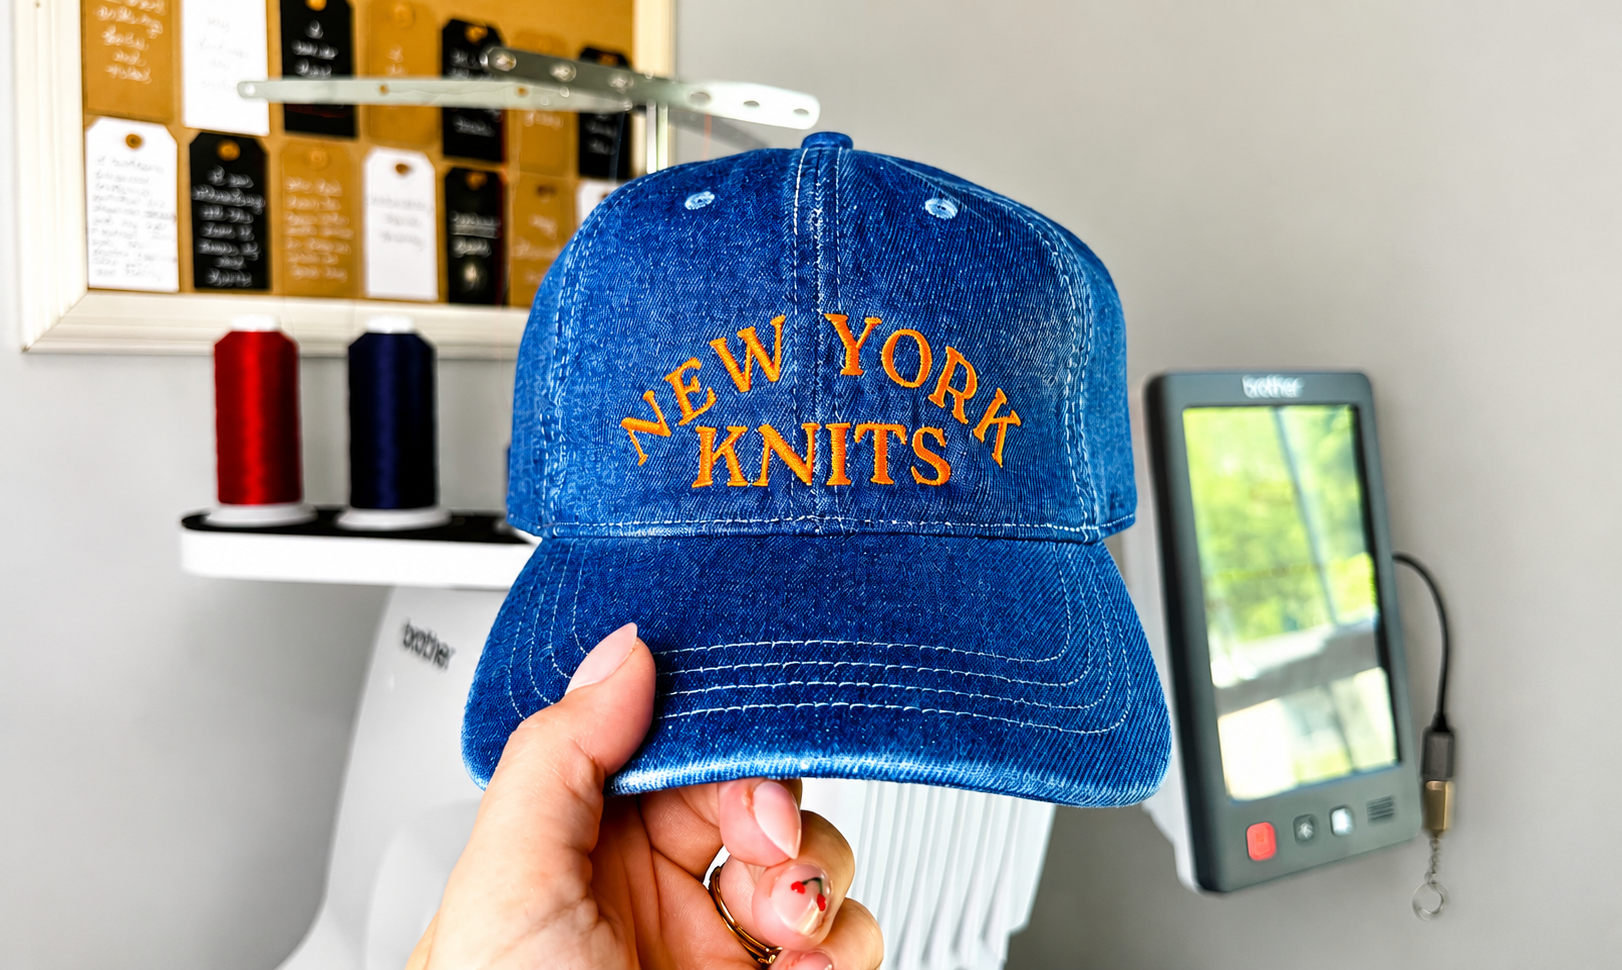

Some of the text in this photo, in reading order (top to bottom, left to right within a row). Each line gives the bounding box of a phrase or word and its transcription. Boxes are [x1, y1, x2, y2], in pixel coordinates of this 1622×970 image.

[621, 313, 1021, 467] NEW YORK
[1242, 374, 1304, 398] brother
[692, 422, 951, 488] KNITS
[402, 620, 456, 671] brother
